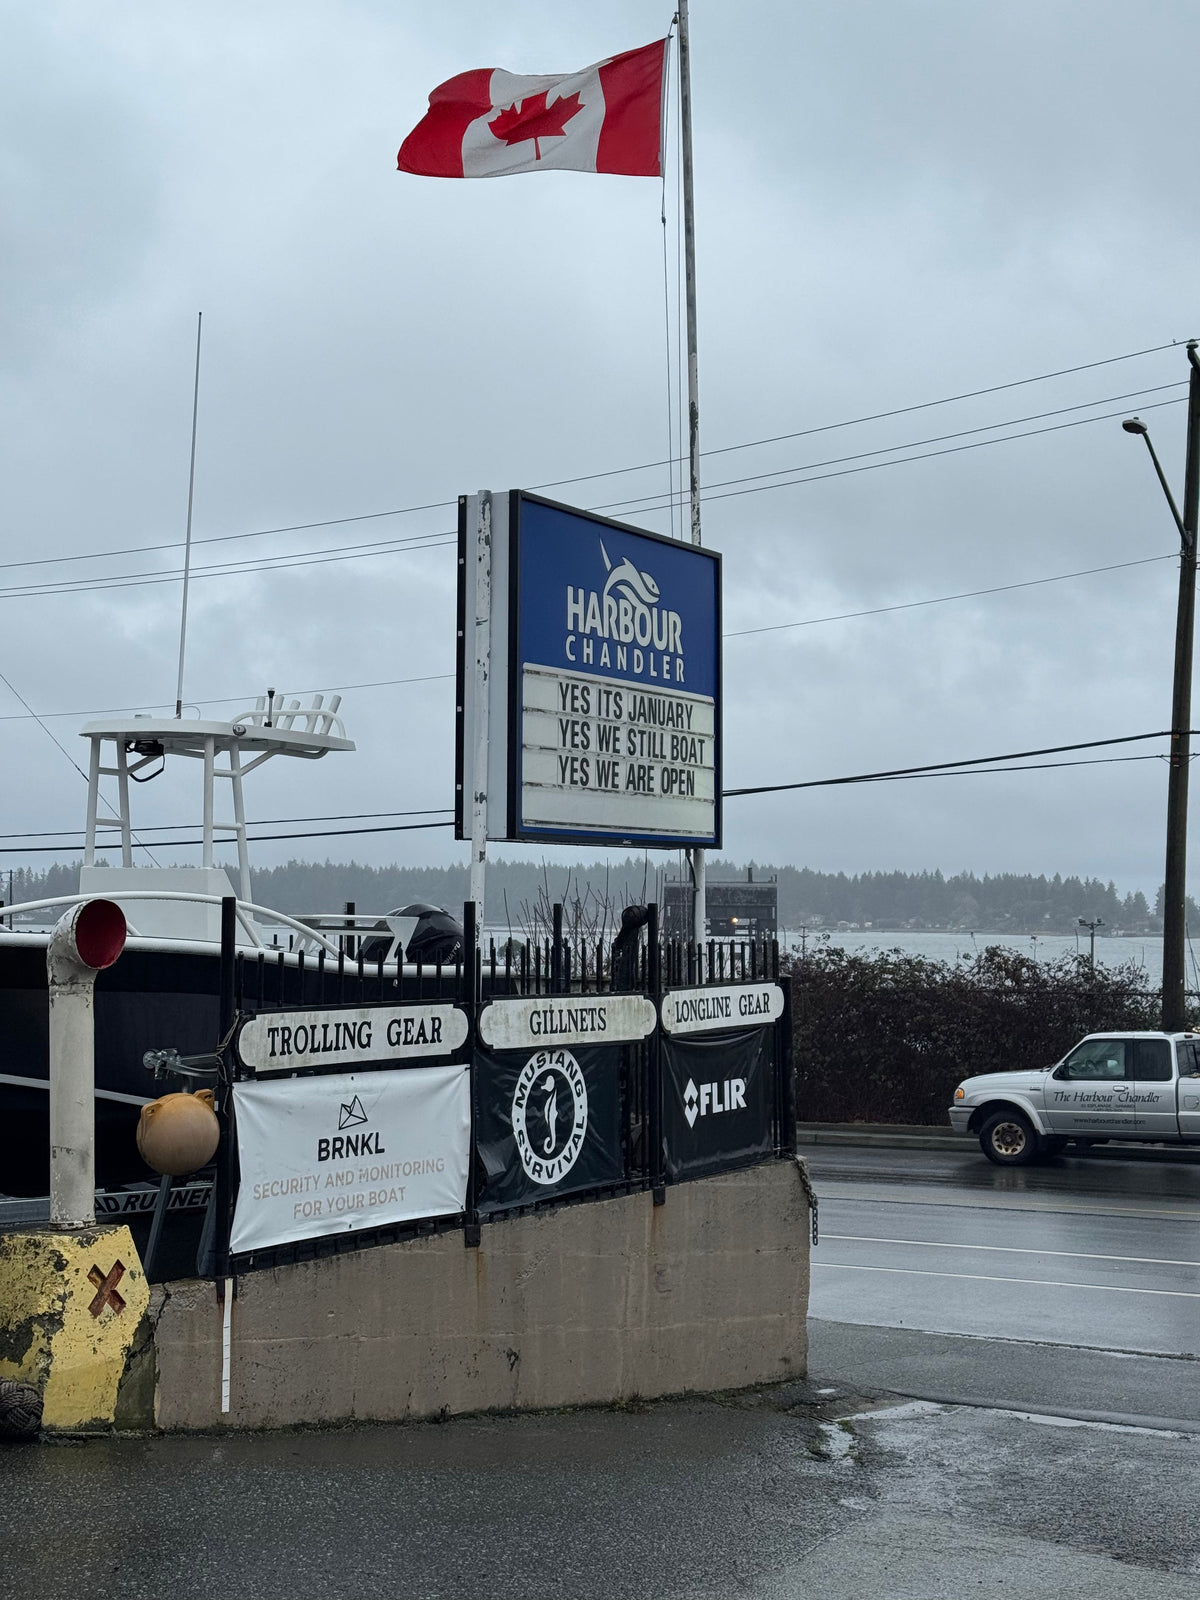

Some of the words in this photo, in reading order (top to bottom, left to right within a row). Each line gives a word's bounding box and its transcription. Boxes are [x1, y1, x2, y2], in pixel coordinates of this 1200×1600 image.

[567, 585, 683, 654] HARBOUR
[565, 635, 685, 683] CHANDLER
[559, 682, 590, 715] YES
[598, 688, 623, 720] ITS
[628, 695, 693, 731] JANUARY
[559, 718, 590, 751] YES
[597, 723, 621, 755] WE
[627, 728, 667, 760] STILL
[671, 736, 706, 766] BOAT
[559, 755, 589, 787] YES
[596, 760, 619, 789] WE
[625, 764, 655, 793] ARE
[661, 768, 695, 797] OPEN
[529, 1007, 607, 1035] GILLNETS
[675, 996, 731, 1023] LONGLINE
[739, 992, 770, 1015] GEAR
[267, 1020, 372, 1057] TROLLING
[386, 1016, 443, 1047] GEAR
[515, 1049, 585, 1109] MUSTANG
[700, 1078, 747, 1116] FLIR
[1054, 1091, 1071, 1102] The
[1074, 1091, 1115, 1102] Harbour
[1118, 1092, 1162, 1103] Chandler
[317, 1132, 385, 1162] BRNKL
[517, 1115, 585, 1179] SURVIVAL
[253, 1174, 321, 1201] SECURITY
[324, 1169, 355, 1189] AND
[358, 1157, 446, 1184] MONITORING
[294, 1199, 323, 1220] FOR
[327, 1193, 365, 1213] YOUR
[369, 1185, 407, 1207] BOAT
